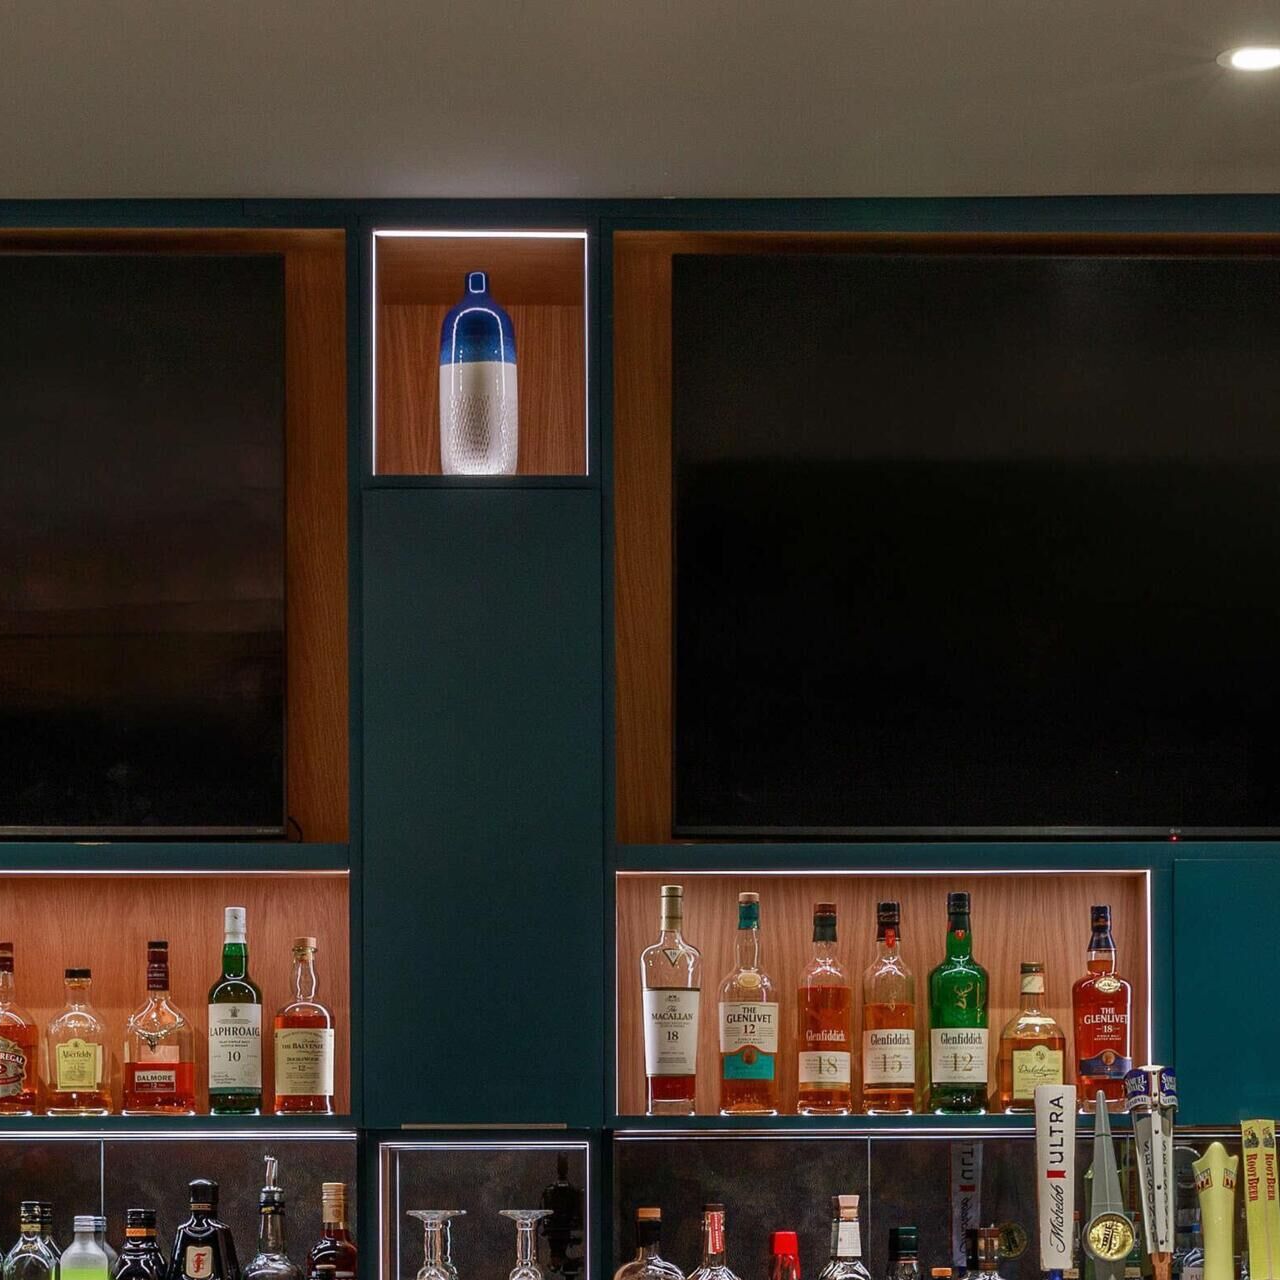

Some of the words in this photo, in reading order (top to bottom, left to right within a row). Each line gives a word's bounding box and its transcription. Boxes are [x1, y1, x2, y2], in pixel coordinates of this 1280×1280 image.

[742, 1006, 756, 1014] THE
[1100, 1007, 1115, 1015] THE
[726, 1014, 772, 1024] GLENLIVET
[1083, 1014, 1128, 1024] GLENLIVET
[210, 1026, 260, 1037] LAPHROAIG
[666, 1030, 679, 1040] 18
[743, 1024, 756, 1034] 12
[1103, 1025, 1113, 1033] 18
[805, 1029, 846, 1042] Glenfiddich
[870, 1032, 911, 1045] Glenfiddich
[940, 1031, 982, 1045] Glenfiddich
[0, 1051, 24, 1064] REGAL
[228, 1051, 241, 1062] 10
[951, 1052, 973, 1072] 12
[817, 1055, 838, 1075] 18
[882, 1053, 903, 1073] 15
[1049, 1095, 1064, 1164] ULTRA
[1049, 1183, 1066, 1254] Michelob
